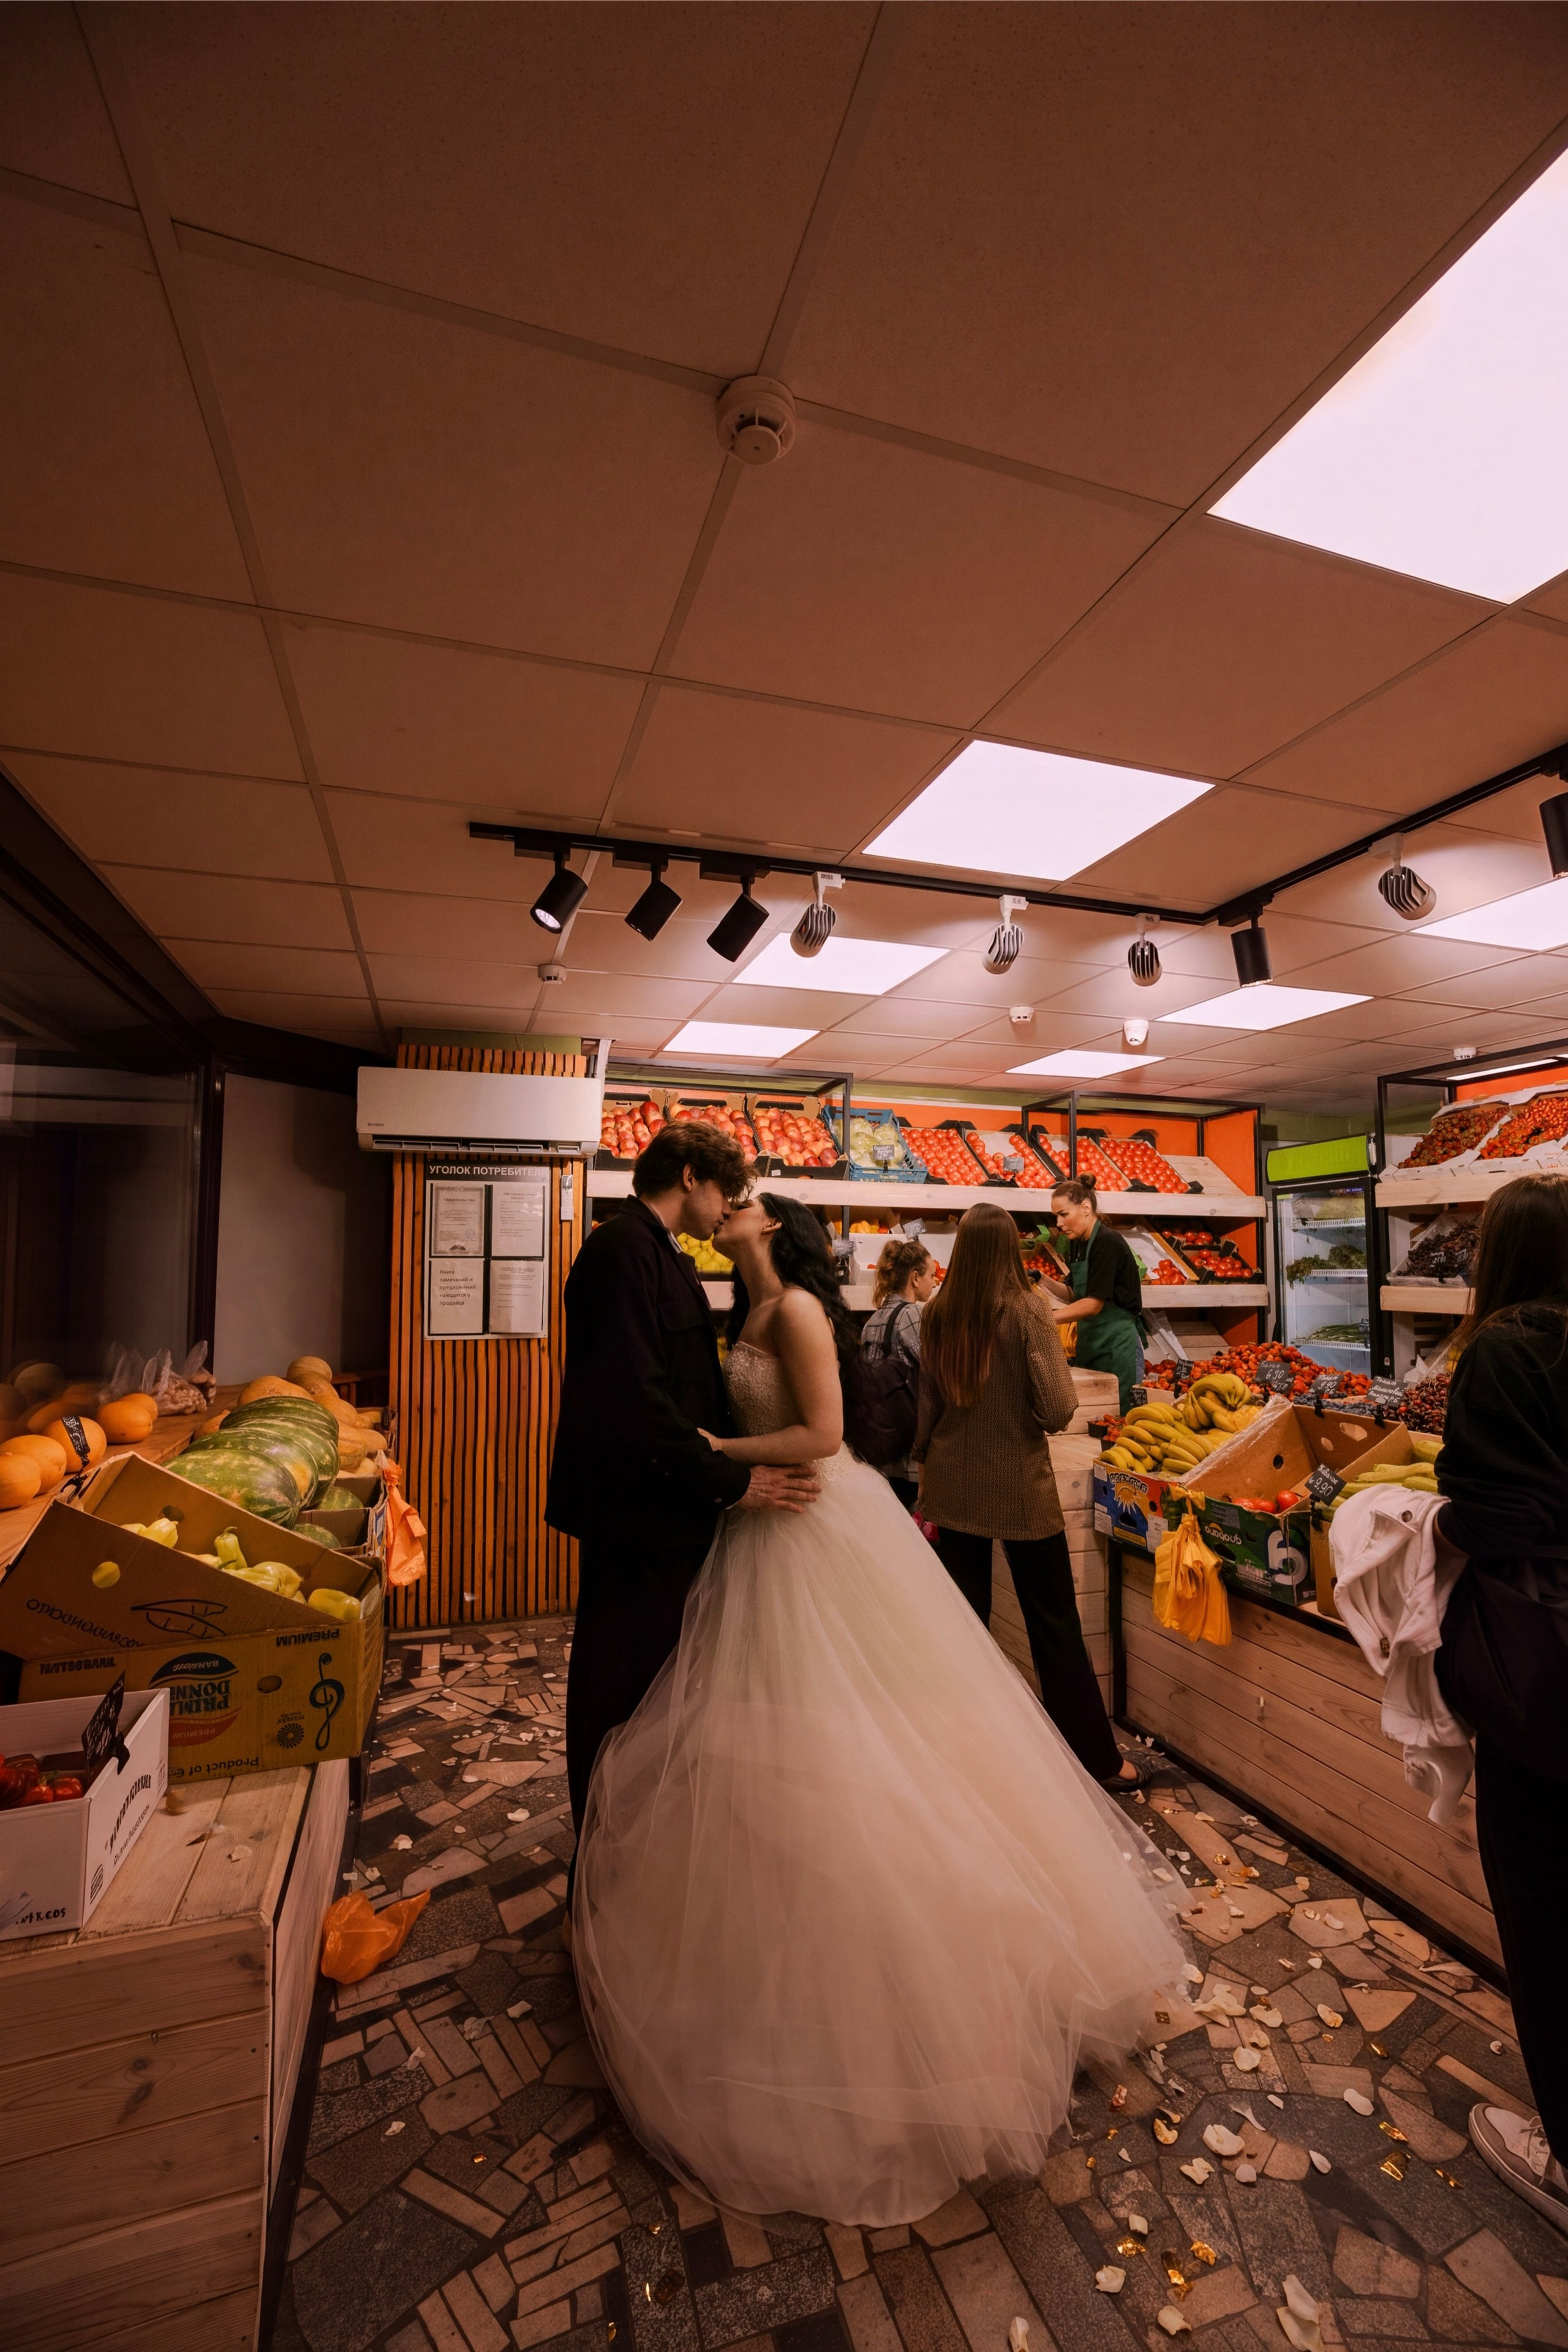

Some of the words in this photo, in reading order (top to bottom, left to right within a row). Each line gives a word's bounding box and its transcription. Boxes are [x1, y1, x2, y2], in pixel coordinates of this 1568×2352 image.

[429, 1166, 471, 1174] УГОЛОК
[473, 1166, 548, 1176] ПОТРЕБИТЕЛЯ
[1314, 1477, 1333, 1496] 9.90
[276, 1629, 341, 1646] PREMIUM
[189, 1766, 203, 1776] of
[206, 1757, 259, 1774] Product
